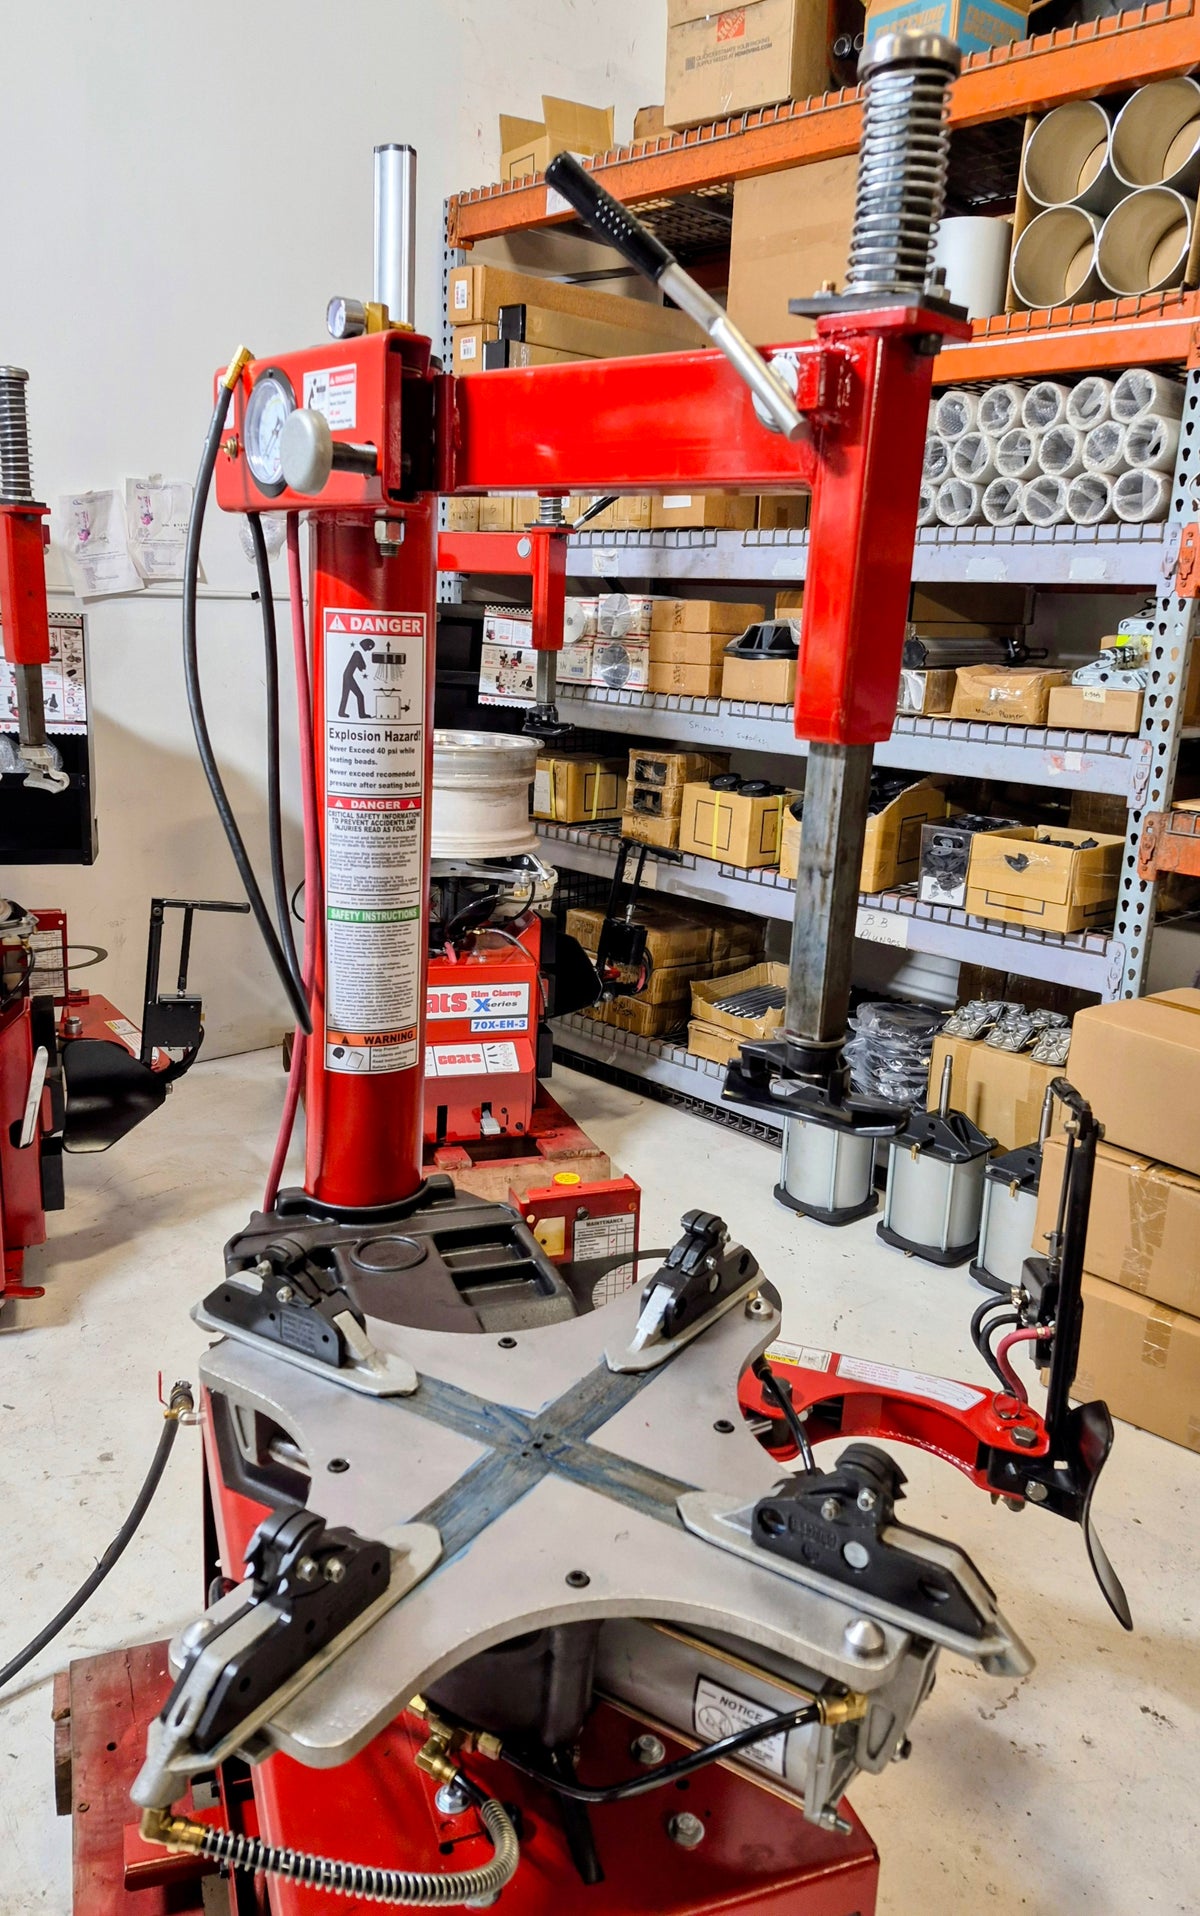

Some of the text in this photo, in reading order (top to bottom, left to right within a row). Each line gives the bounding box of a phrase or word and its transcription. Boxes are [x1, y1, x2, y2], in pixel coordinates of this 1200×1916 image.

[350, 616, 421, 633] DANGER
[329, 728, 421, 742] Explosion Hazard!
[330, 745, 347, 753] Never
[349, 746, 375, 754] Exceed
[330, 756, 352, 766] seating
[349, 770, 375, 778] exceed
[376, 770, 416, 778] recomended
[330, 780, 357, 789] pressure
[378, 782, 403, 790] seating
[351, 800, 401, 809] DANGER
[328, 810, 420, 820] CRITICAL SAFETY INFORMATION
[340, 818, 370, 826] PREVENT
[370, 819, 405, 827] ACCIDENTS
[364, 825, 381, 833] READ
[331, 907, 417, 920] SAFETY INSTRUCTIONS
[471, 990, 489, 998] Rim
[492, 989, 522, 998] Clamp
[473, 1019, 526, 1030] 70X-EH-3
[364, 1031, 414, 1045] WARNING
[586, 1217, 624, 1227] MAINTENANCE
[719, 1696, 764, 1720] NOTICE
